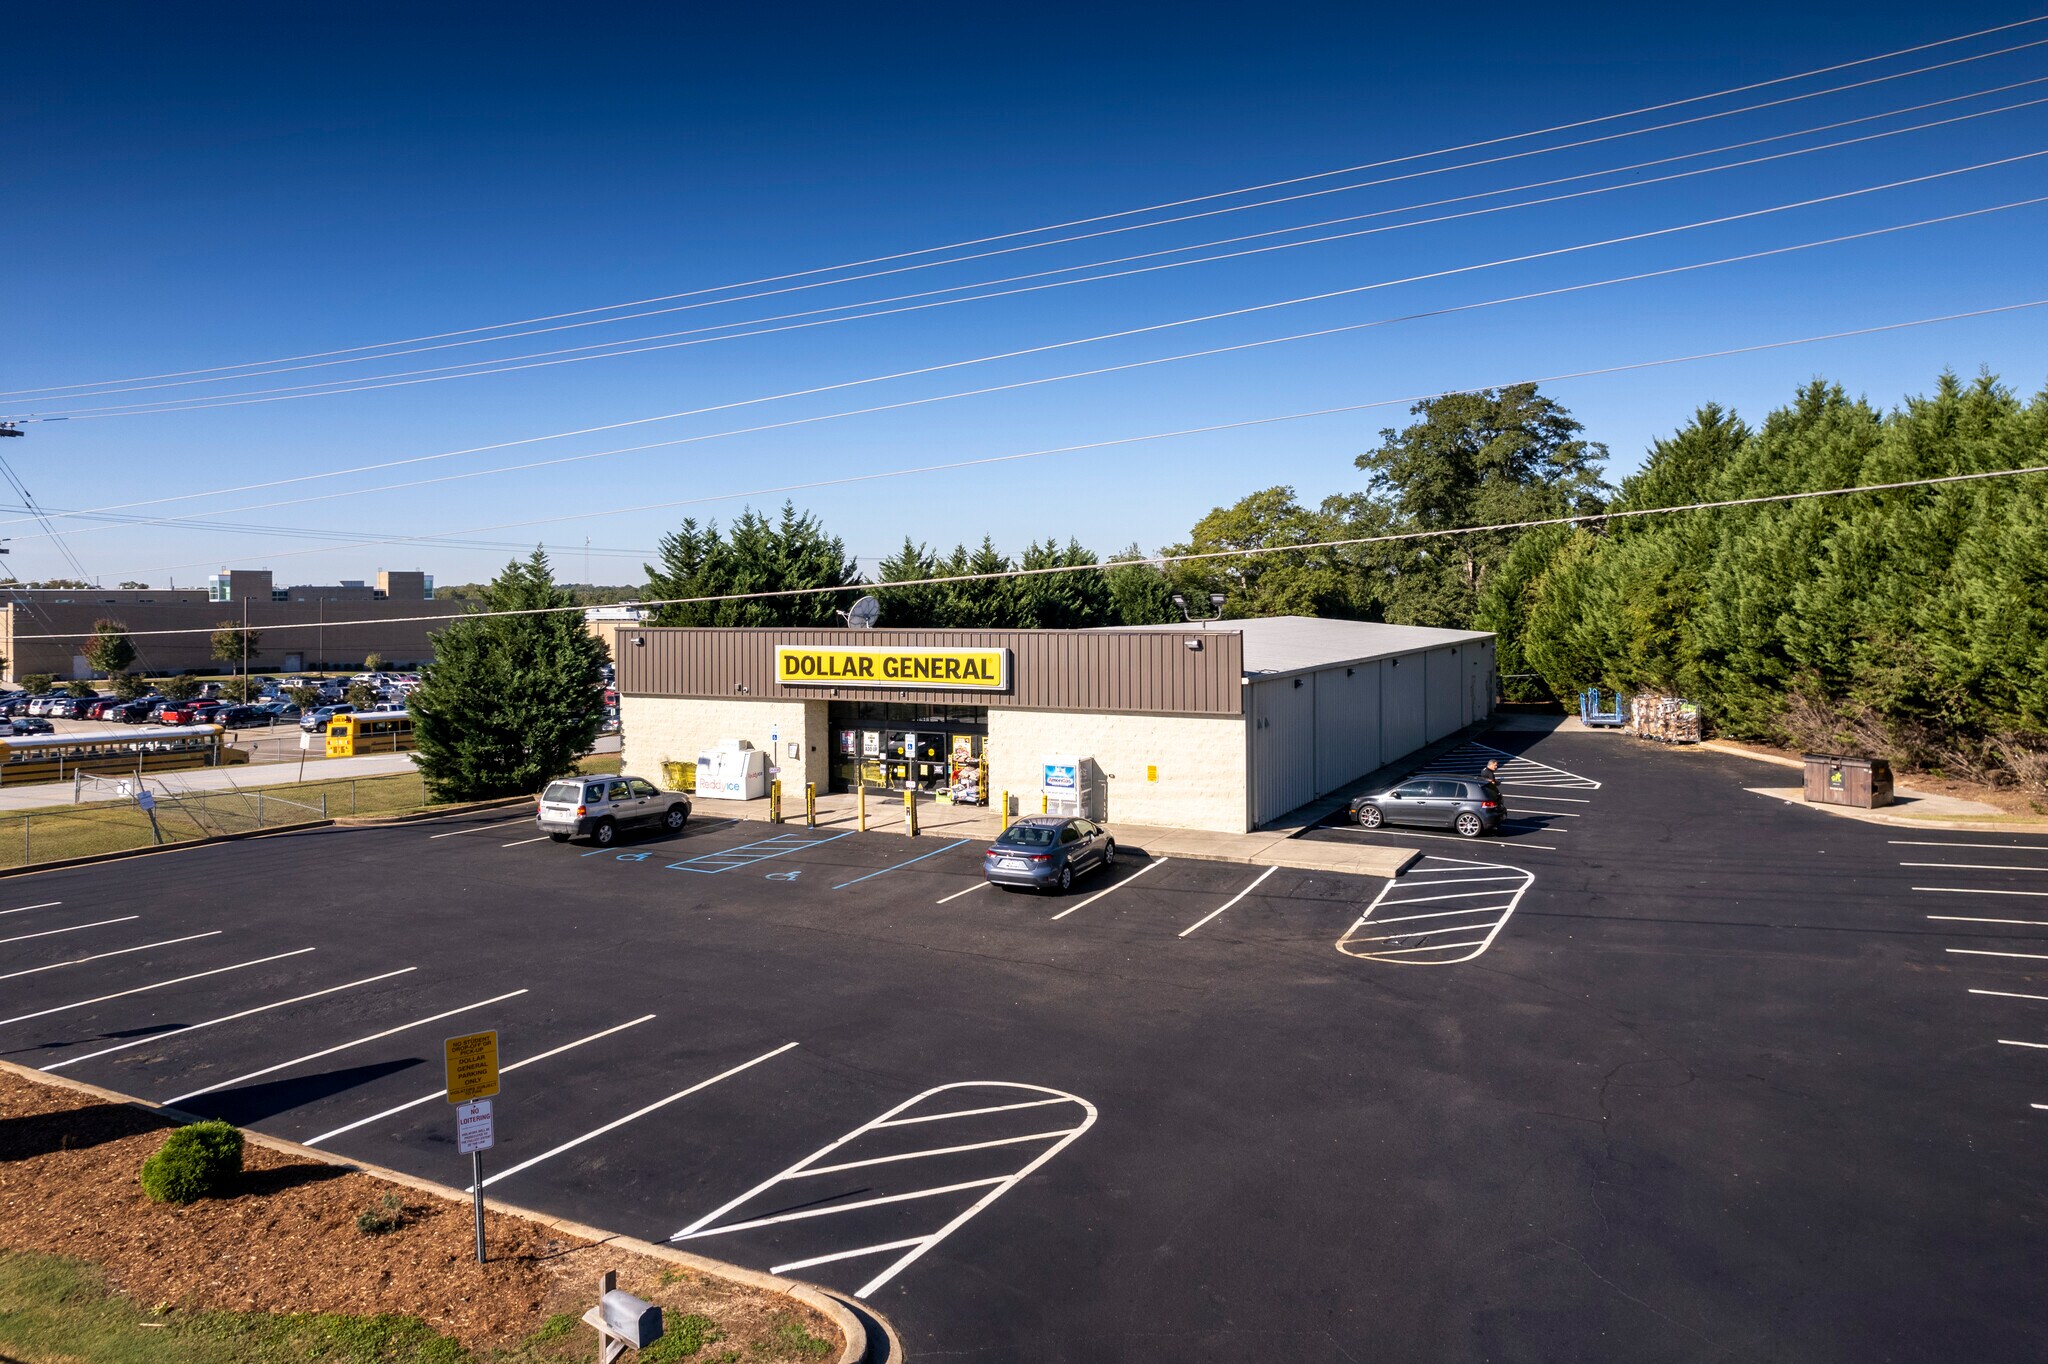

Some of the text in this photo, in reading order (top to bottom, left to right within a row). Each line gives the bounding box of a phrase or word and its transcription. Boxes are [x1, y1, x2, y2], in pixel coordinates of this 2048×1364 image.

[784, 655, 994, 680] DOLLAR GENERAL
[463, 1036, 490, 1045] STUDENT
[459, 1055, 486, 1064] DOLLAR
[457, 1062, 488, 1072] GENERAL
[458, 1069, 487, 1079] PARKING
[465, 1077, 482, 1085] ONLY
[460, 1113, 490, 1125] LOITERING
